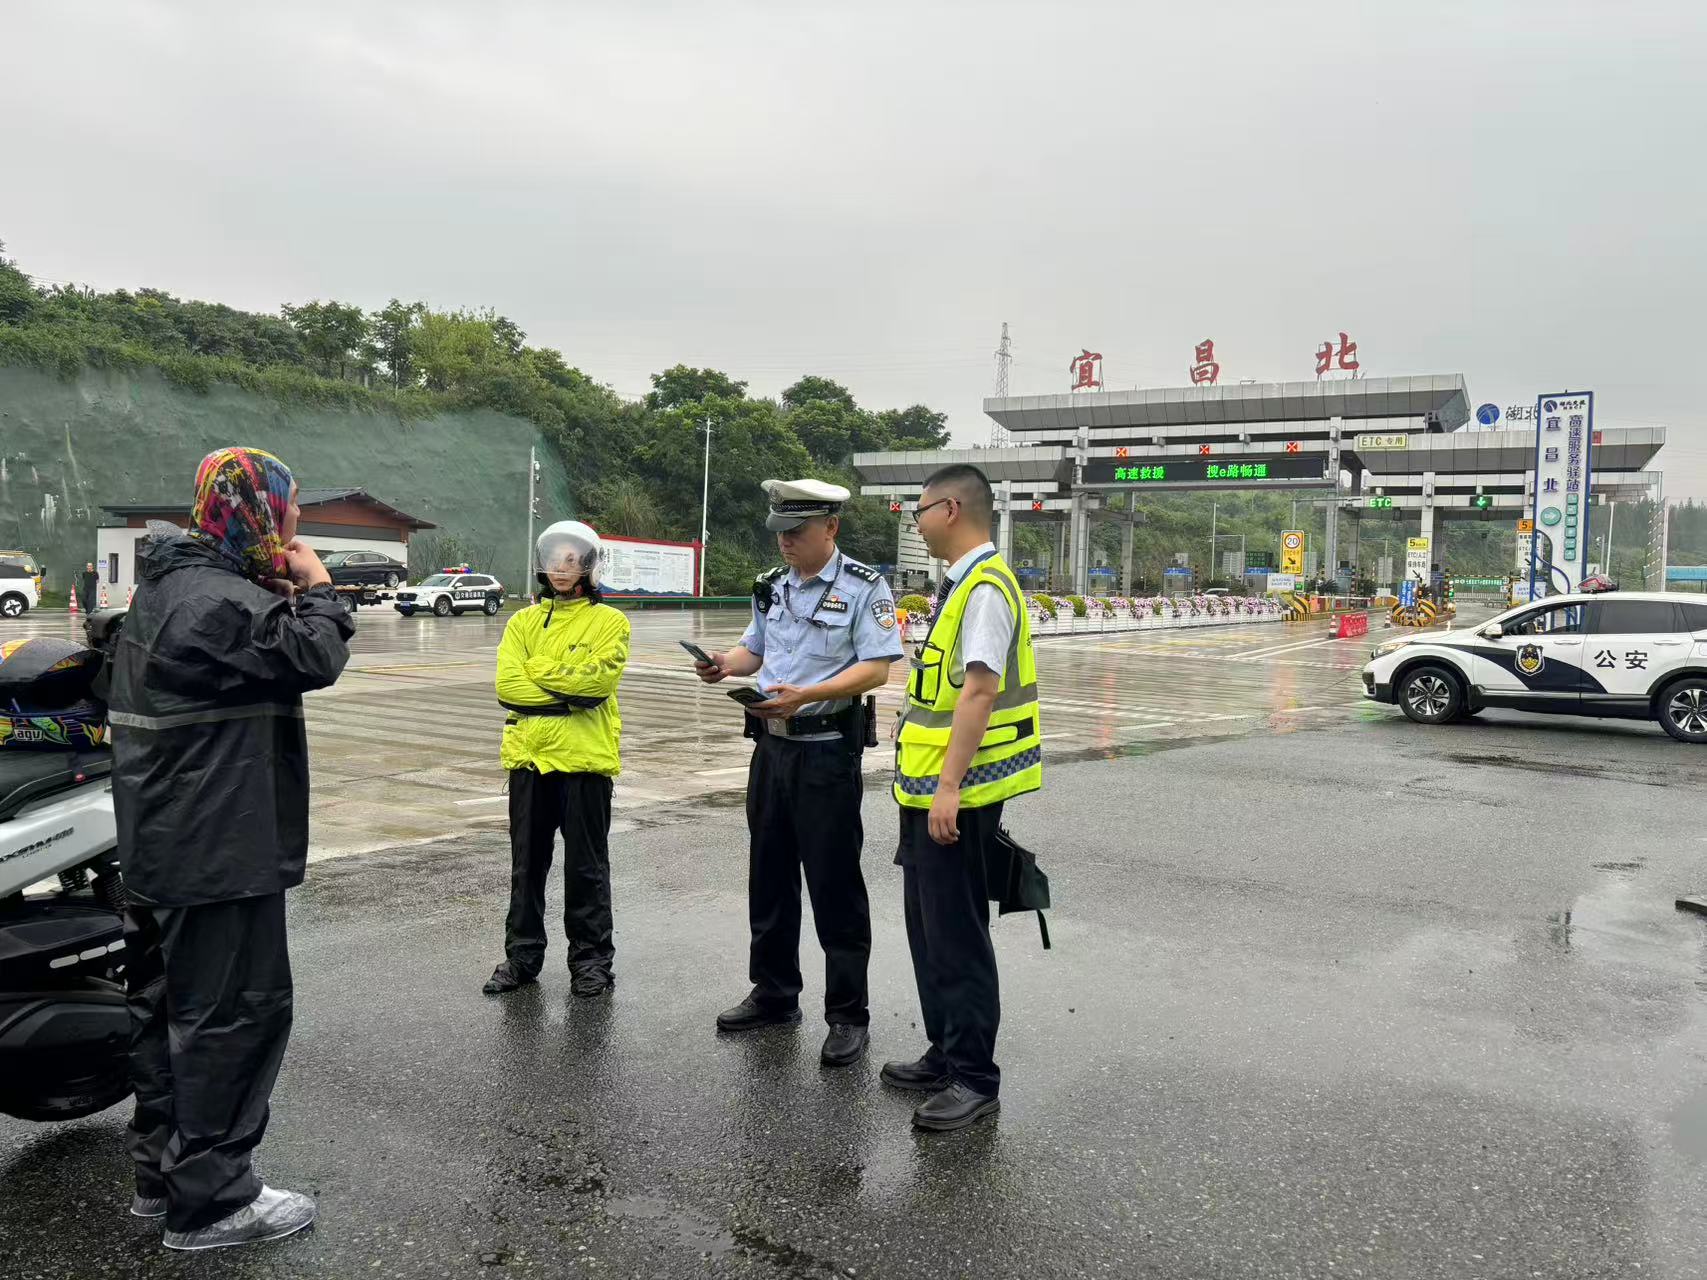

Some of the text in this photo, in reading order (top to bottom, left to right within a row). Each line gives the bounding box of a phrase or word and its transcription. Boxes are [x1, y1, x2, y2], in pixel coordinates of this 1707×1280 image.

[1069, 332, 1360, 391] 宜昌北
[1361, 436, 1382, 447] ETC
[1543, 415, 1562, 493] 宜昌北
[1114, 465, 1165, 480] 高速救援
[1369, 498, 1392, 508] ETC
[1287, 537, 1299, 546] 20
[1593, 649, 1649, 671] 公安
